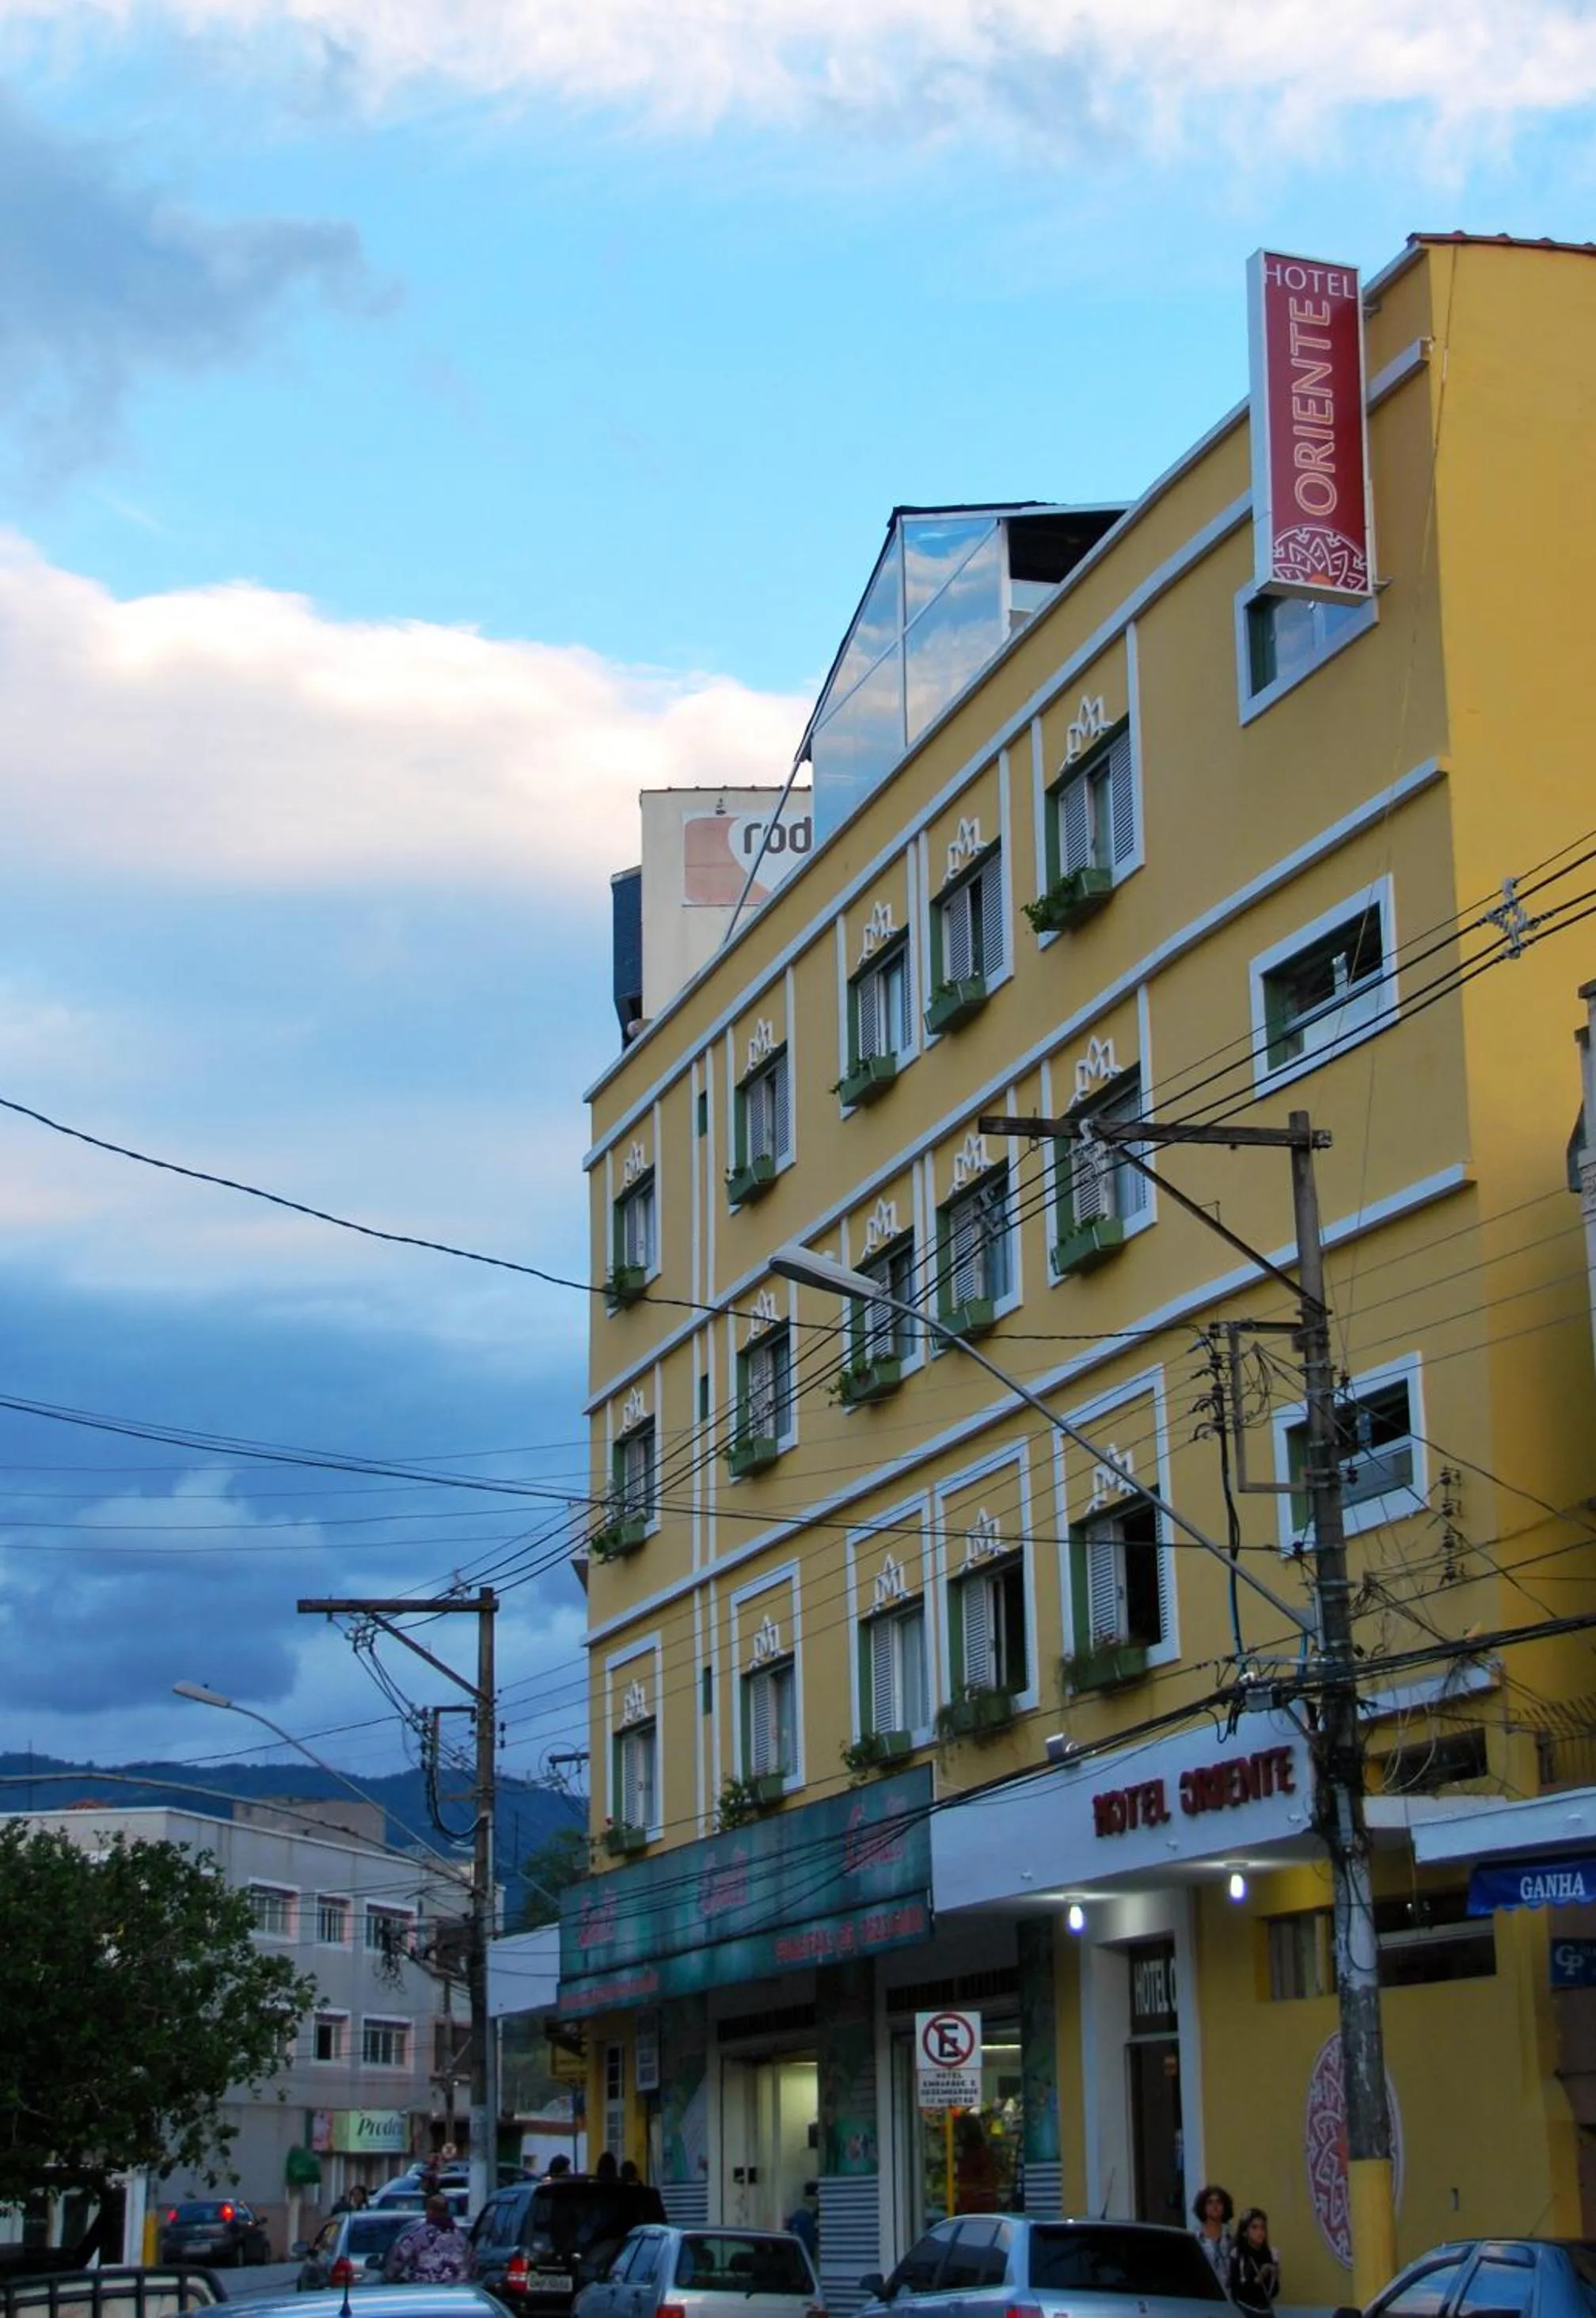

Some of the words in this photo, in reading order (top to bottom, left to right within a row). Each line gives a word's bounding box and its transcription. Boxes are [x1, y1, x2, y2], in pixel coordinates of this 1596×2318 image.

[1266, 263, 1356, 299] HOTEL
[1289, 296, 1338, 517] ORIENTE
[1092, 1778, 1172, 1837] HOTEL
[1179, 1745, 1297, 1816] ORIENTE
[1520, 1872, 1586, 1900] GANHA
